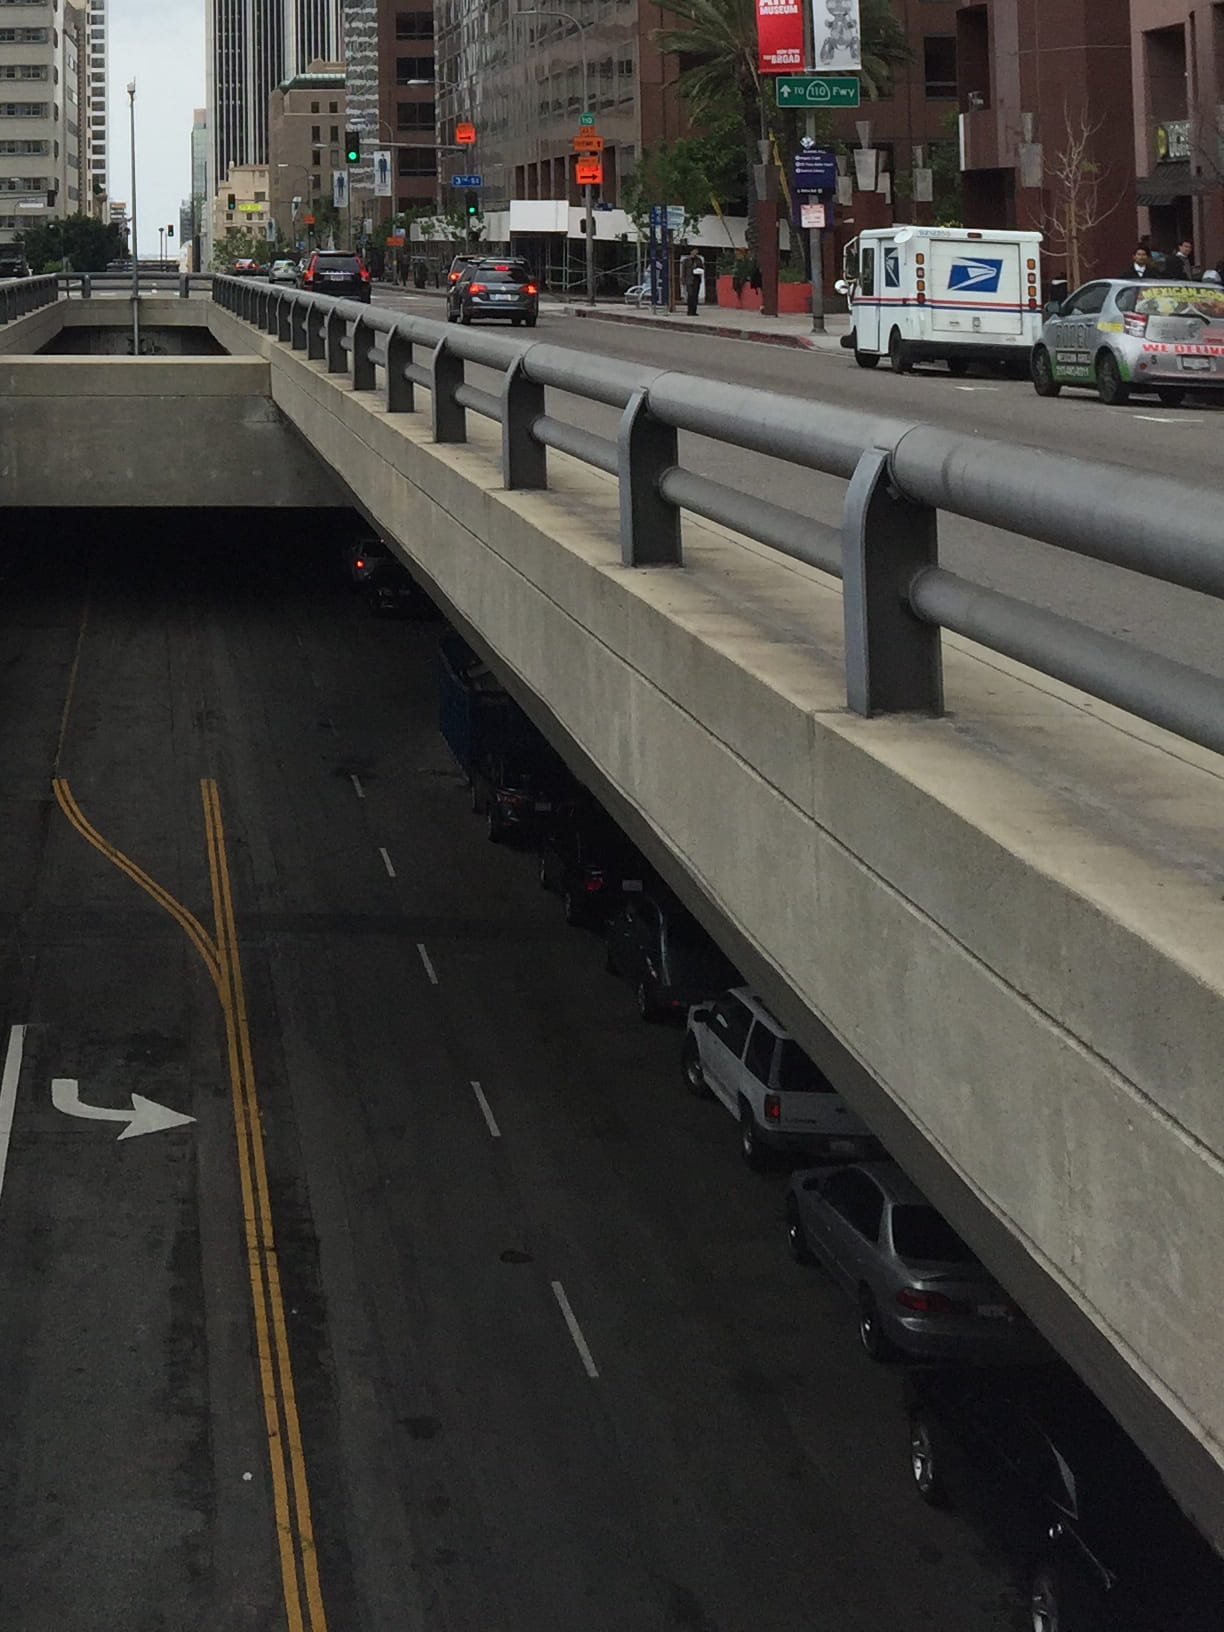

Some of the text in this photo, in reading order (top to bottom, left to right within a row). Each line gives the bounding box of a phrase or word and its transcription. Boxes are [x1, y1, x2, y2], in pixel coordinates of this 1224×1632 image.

[760, 4, 798, 15] MUSEUM
[771, 54, 800, 64] BROAD
[810, 85, 826, 96] 110
[833, 86, 855, 97] Fwy
[1142, 288, 1196, 300] MEXICAN
[1142, 344, 1169, 353] WE
